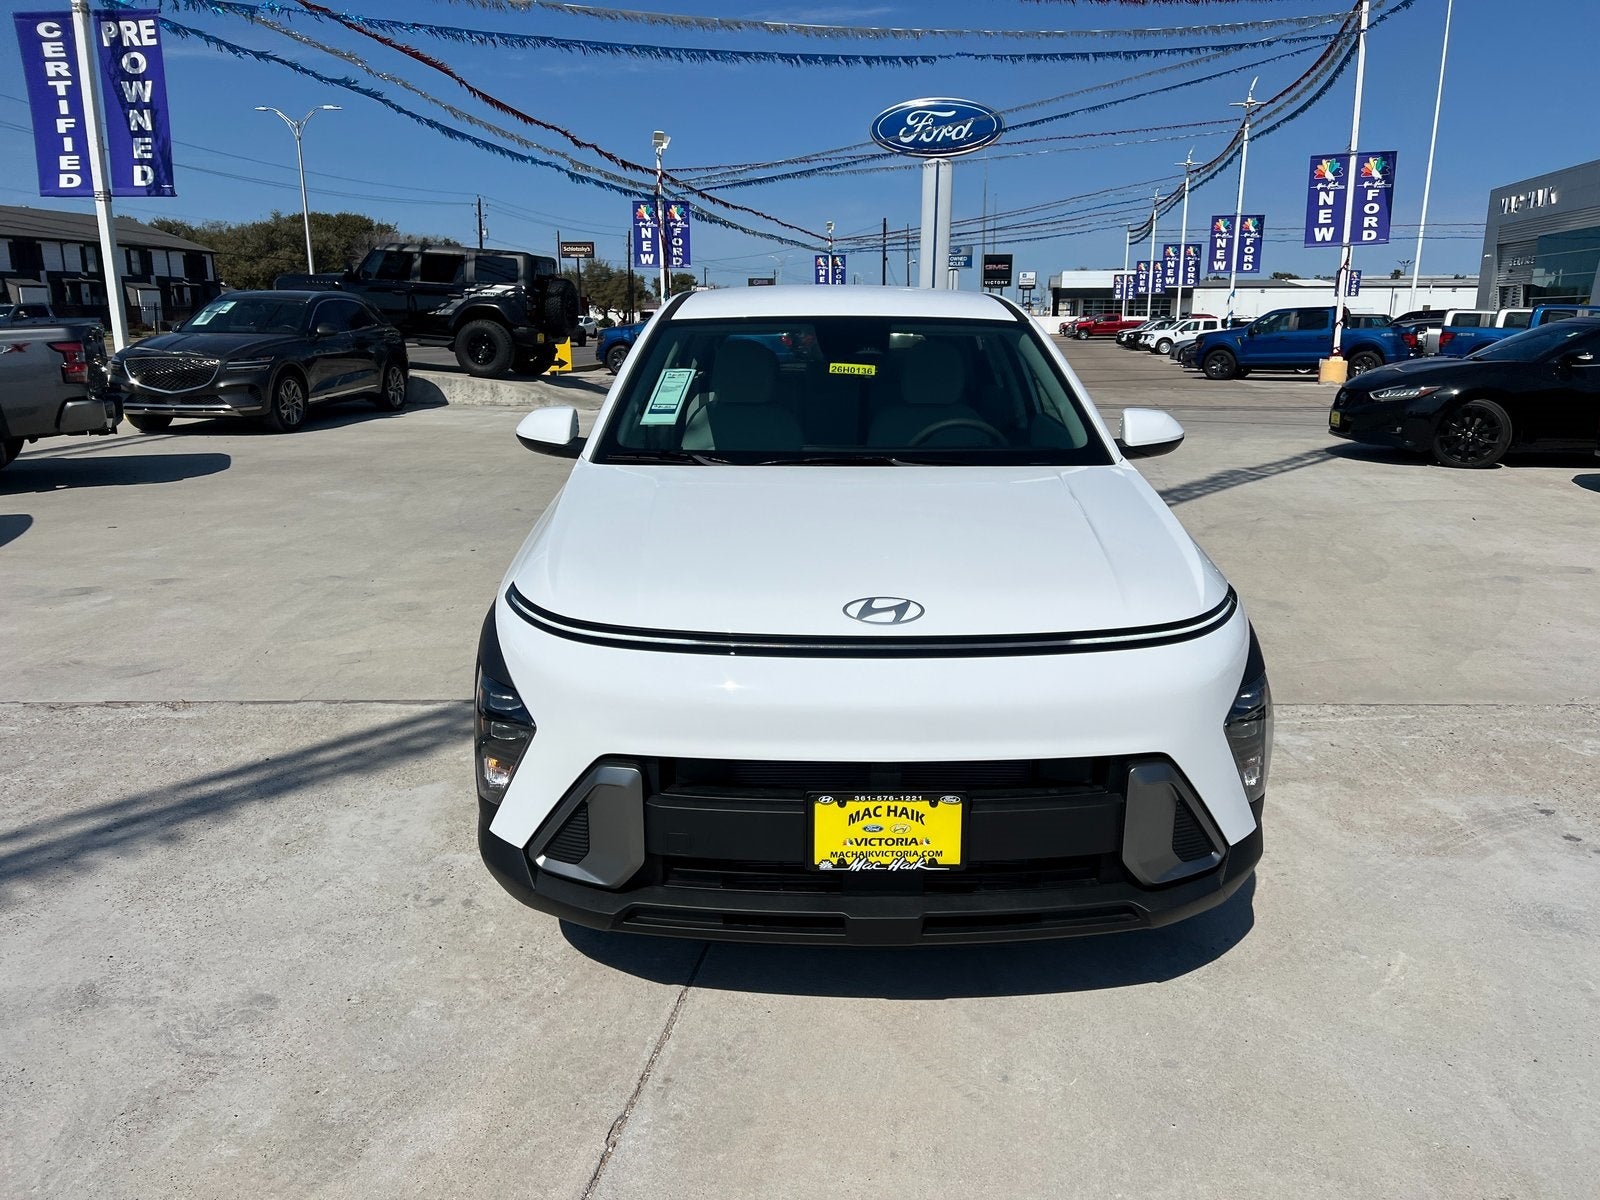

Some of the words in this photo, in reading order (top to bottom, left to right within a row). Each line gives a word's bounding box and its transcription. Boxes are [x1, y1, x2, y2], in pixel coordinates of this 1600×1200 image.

[101, 19, 157, 47] PRE
[36, 21, 82, 188] CERTIFIED
[120, 51, 155, 187] OWNED
[898, 109, 974, 143] Ford
[1313, 190, 1335, 242] NEW
[1362, 189, 1380, 241] FORD
[640, 227, 654, 265] NEW
[671, 228, 683, 265] FORD
[1213, 238, 1227, 271] NEW
[1242, 238, 1255, 271] FORD
[1138, 273, 1146, 293] NEW
[1165, 260, 1175, 285] NEW
[1187, 260, 1196, 285] FORD
[831, 365, 873, 375] 26H0136
[847, 805, 883, 827] MAC
[886, 805, 925, 826] HAIK
[830, 850, 943, 858] MACHAIKVICTORIA.COM
[853, 837, 919, 847] VICTORIA
[847, 857, 886, 871] Mac
[887, 857, 927, 871] Haik
